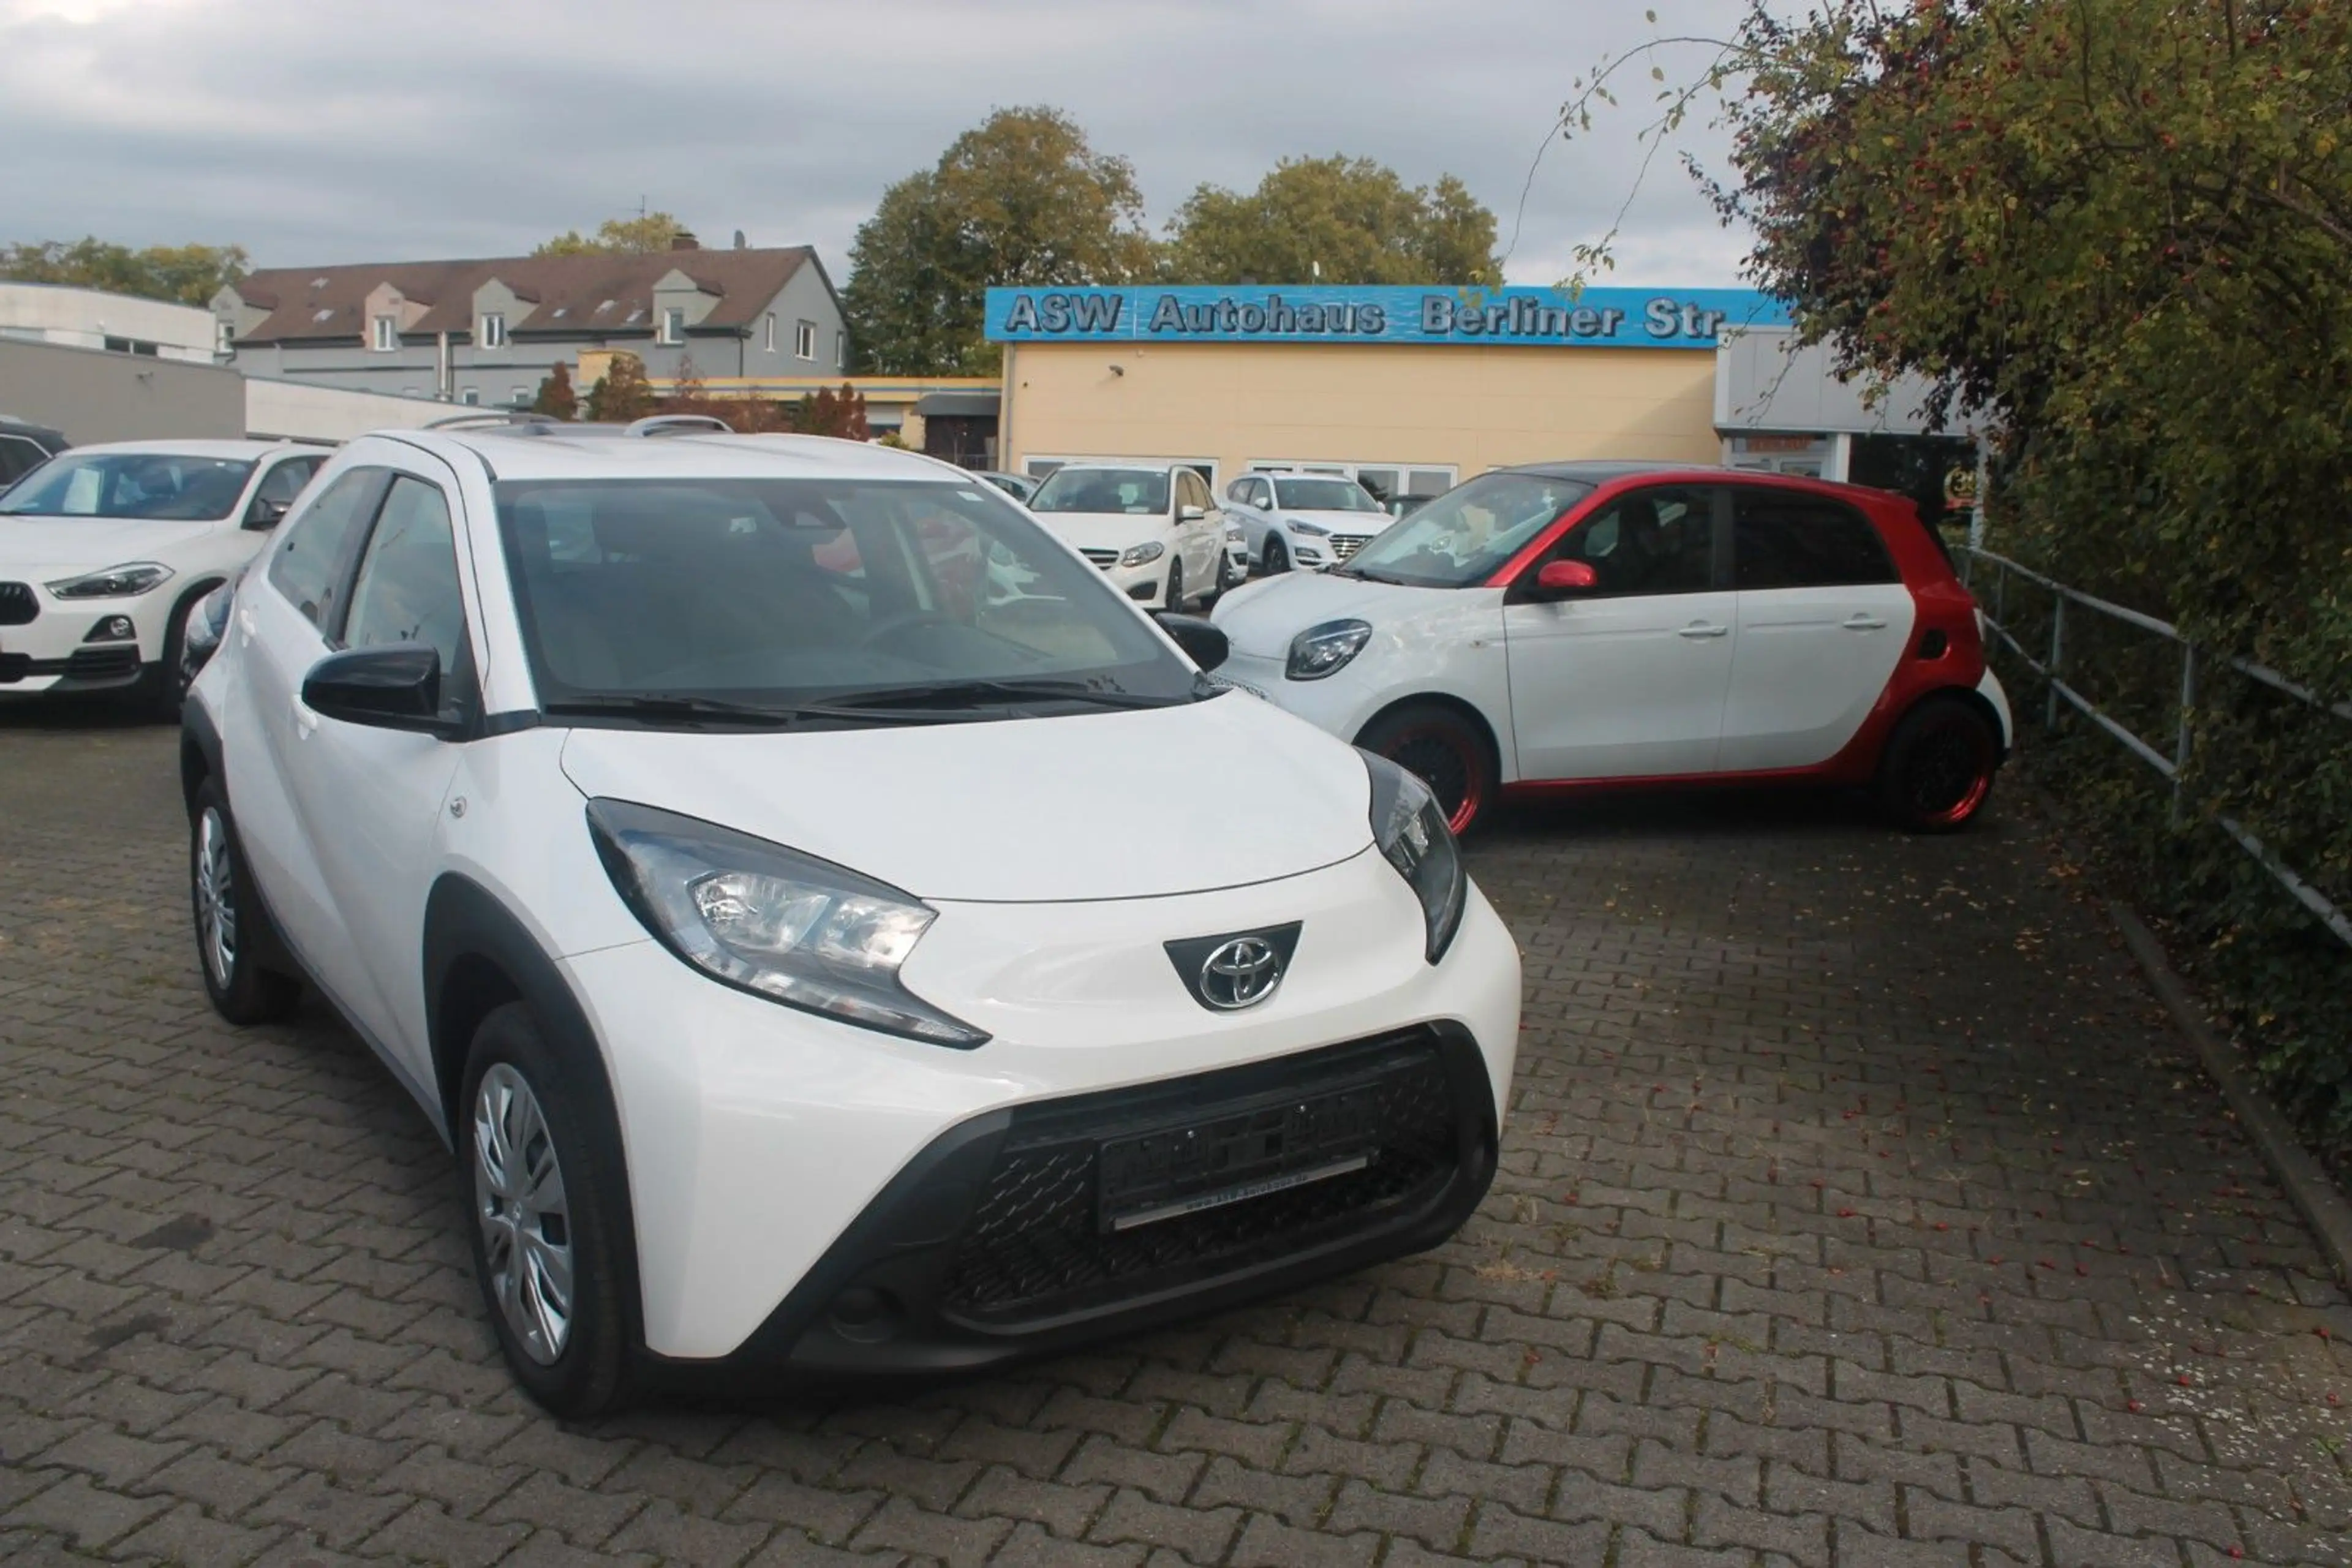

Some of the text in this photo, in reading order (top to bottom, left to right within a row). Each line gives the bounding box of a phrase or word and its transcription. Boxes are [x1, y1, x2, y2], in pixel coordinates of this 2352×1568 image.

[1005, 293, 1123, 333] ASW
[1148, 295, 1385, 334] Autohaus
[1421, 294, 1624, 337] Berliner
